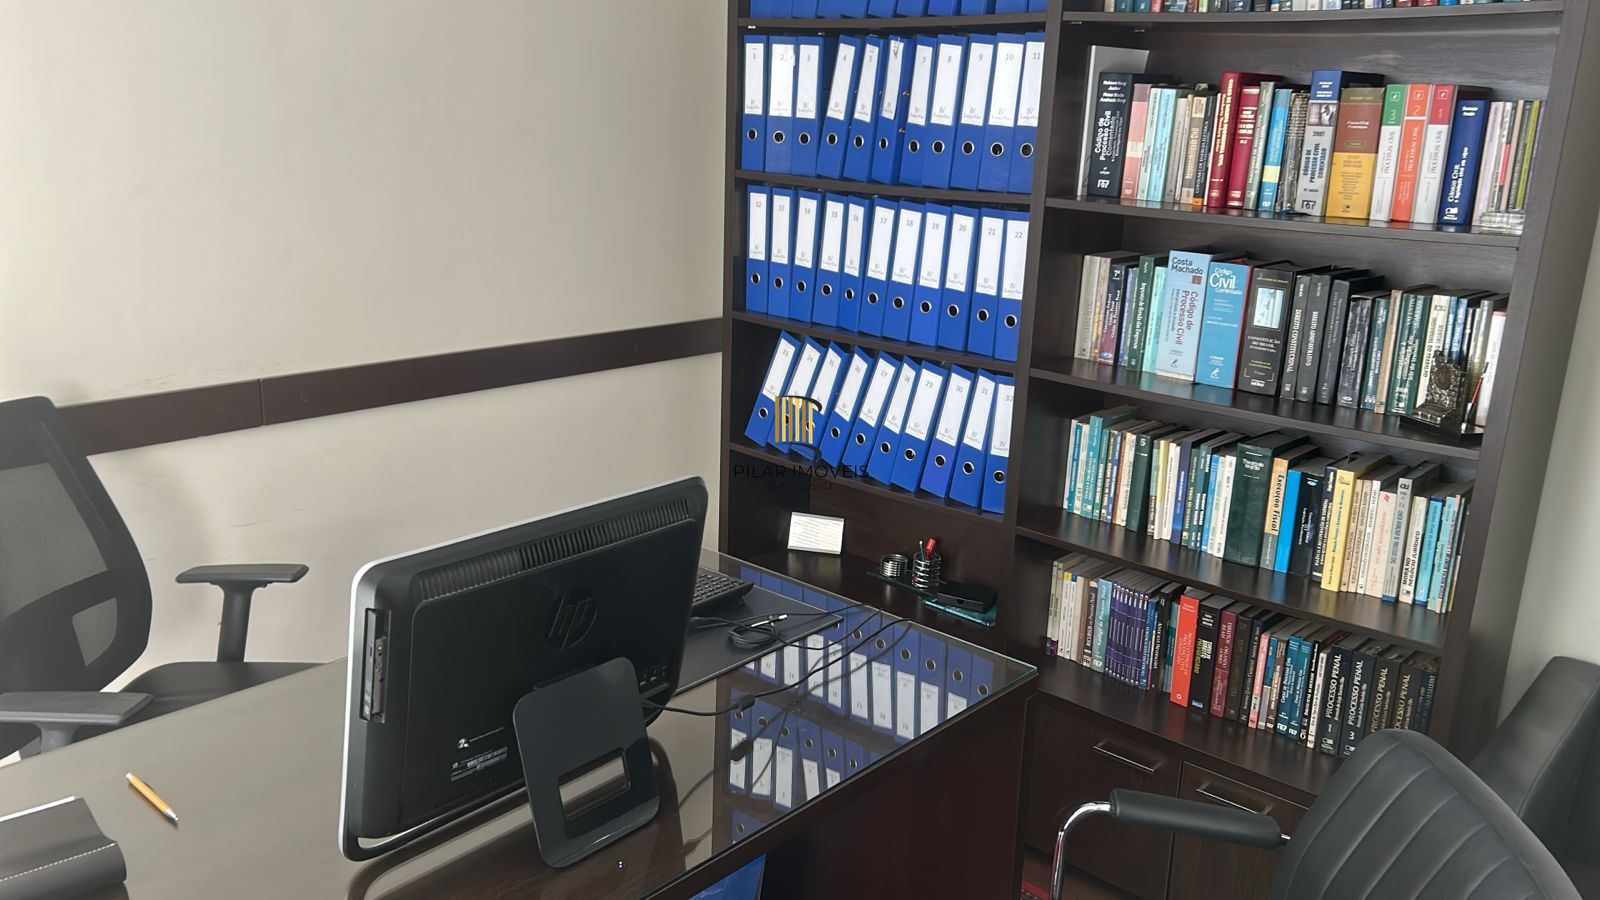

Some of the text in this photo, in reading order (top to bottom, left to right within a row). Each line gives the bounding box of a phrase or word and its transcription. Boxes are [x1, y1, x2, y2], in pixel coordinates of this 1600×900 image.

[1095, 117, 1104, 153] Código de
[1100, 127, 1109, 160] Processo
[1303, 155, 1311, 176] CÓDIGO
[1310, 154, 1318, 182] PROCESSO
[1171, 264, 1203, 275] Machado
[1172, 257, 1193, 266] Costa
[1210, 272, 1237, 288] Civil
[1175, 290, 1190, 345] Processo Civil
[1187, 291, 1198, 330] Código de
[1422, 353, 1431, 377] TRABALHO
[1270, 474, 1284, 531] Execução Fiscal
[1405, 557, 1410, 566] NO
[1408, 531, 1420, 586] NEGÓCIO JURÍDICO
[547, 590, 594, 648] hp
[1326, 653, 1341, 718] PROCESSO PENAL
[1348, 659, 1363, 725] PROCESSO PENAL
[1370, 666, 1388, 732] PROCESSO PENAL
[1394, 674, 1411, 729] OCESSO PENAL
